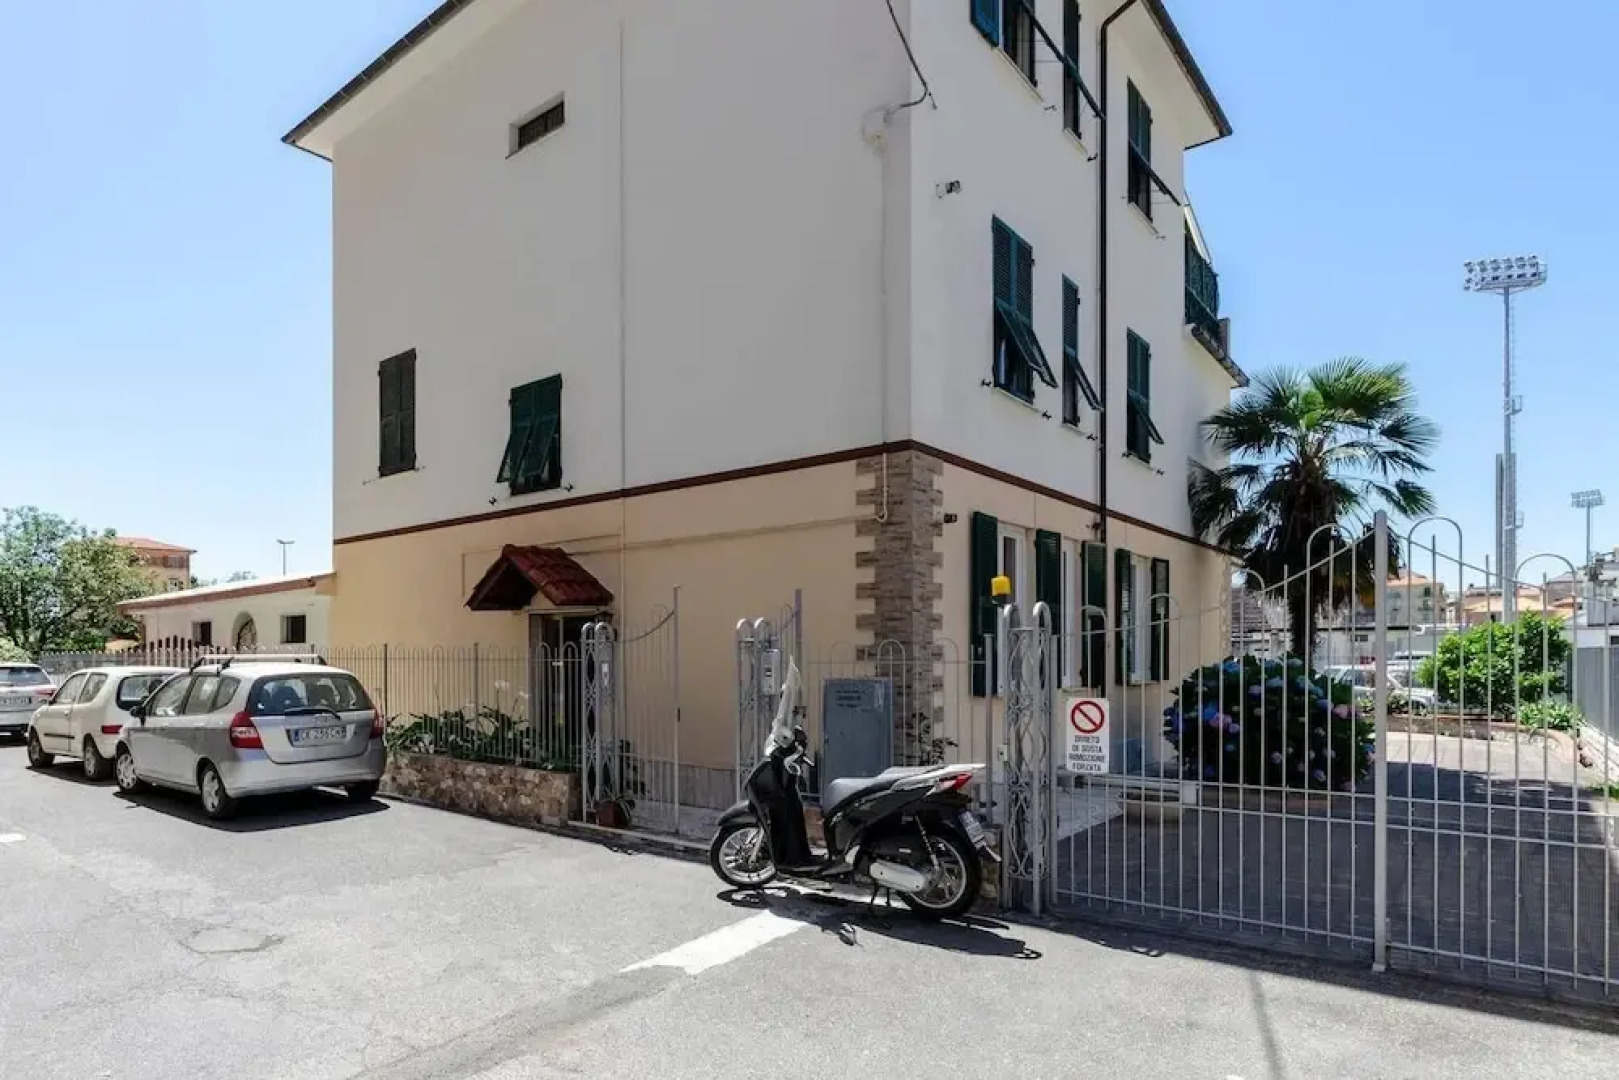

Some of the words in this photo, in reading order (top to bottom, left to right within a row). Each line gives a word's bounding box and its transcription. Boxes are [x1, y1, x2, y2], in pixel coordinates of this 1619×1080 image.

[1072, 744, 1079, 752] DI
[1081, 745, 1102, 753] SOSTA
[1069, 753, 1105, 762] RIMOZIONE
[1072, 763, 1101, 771] FORZATA
